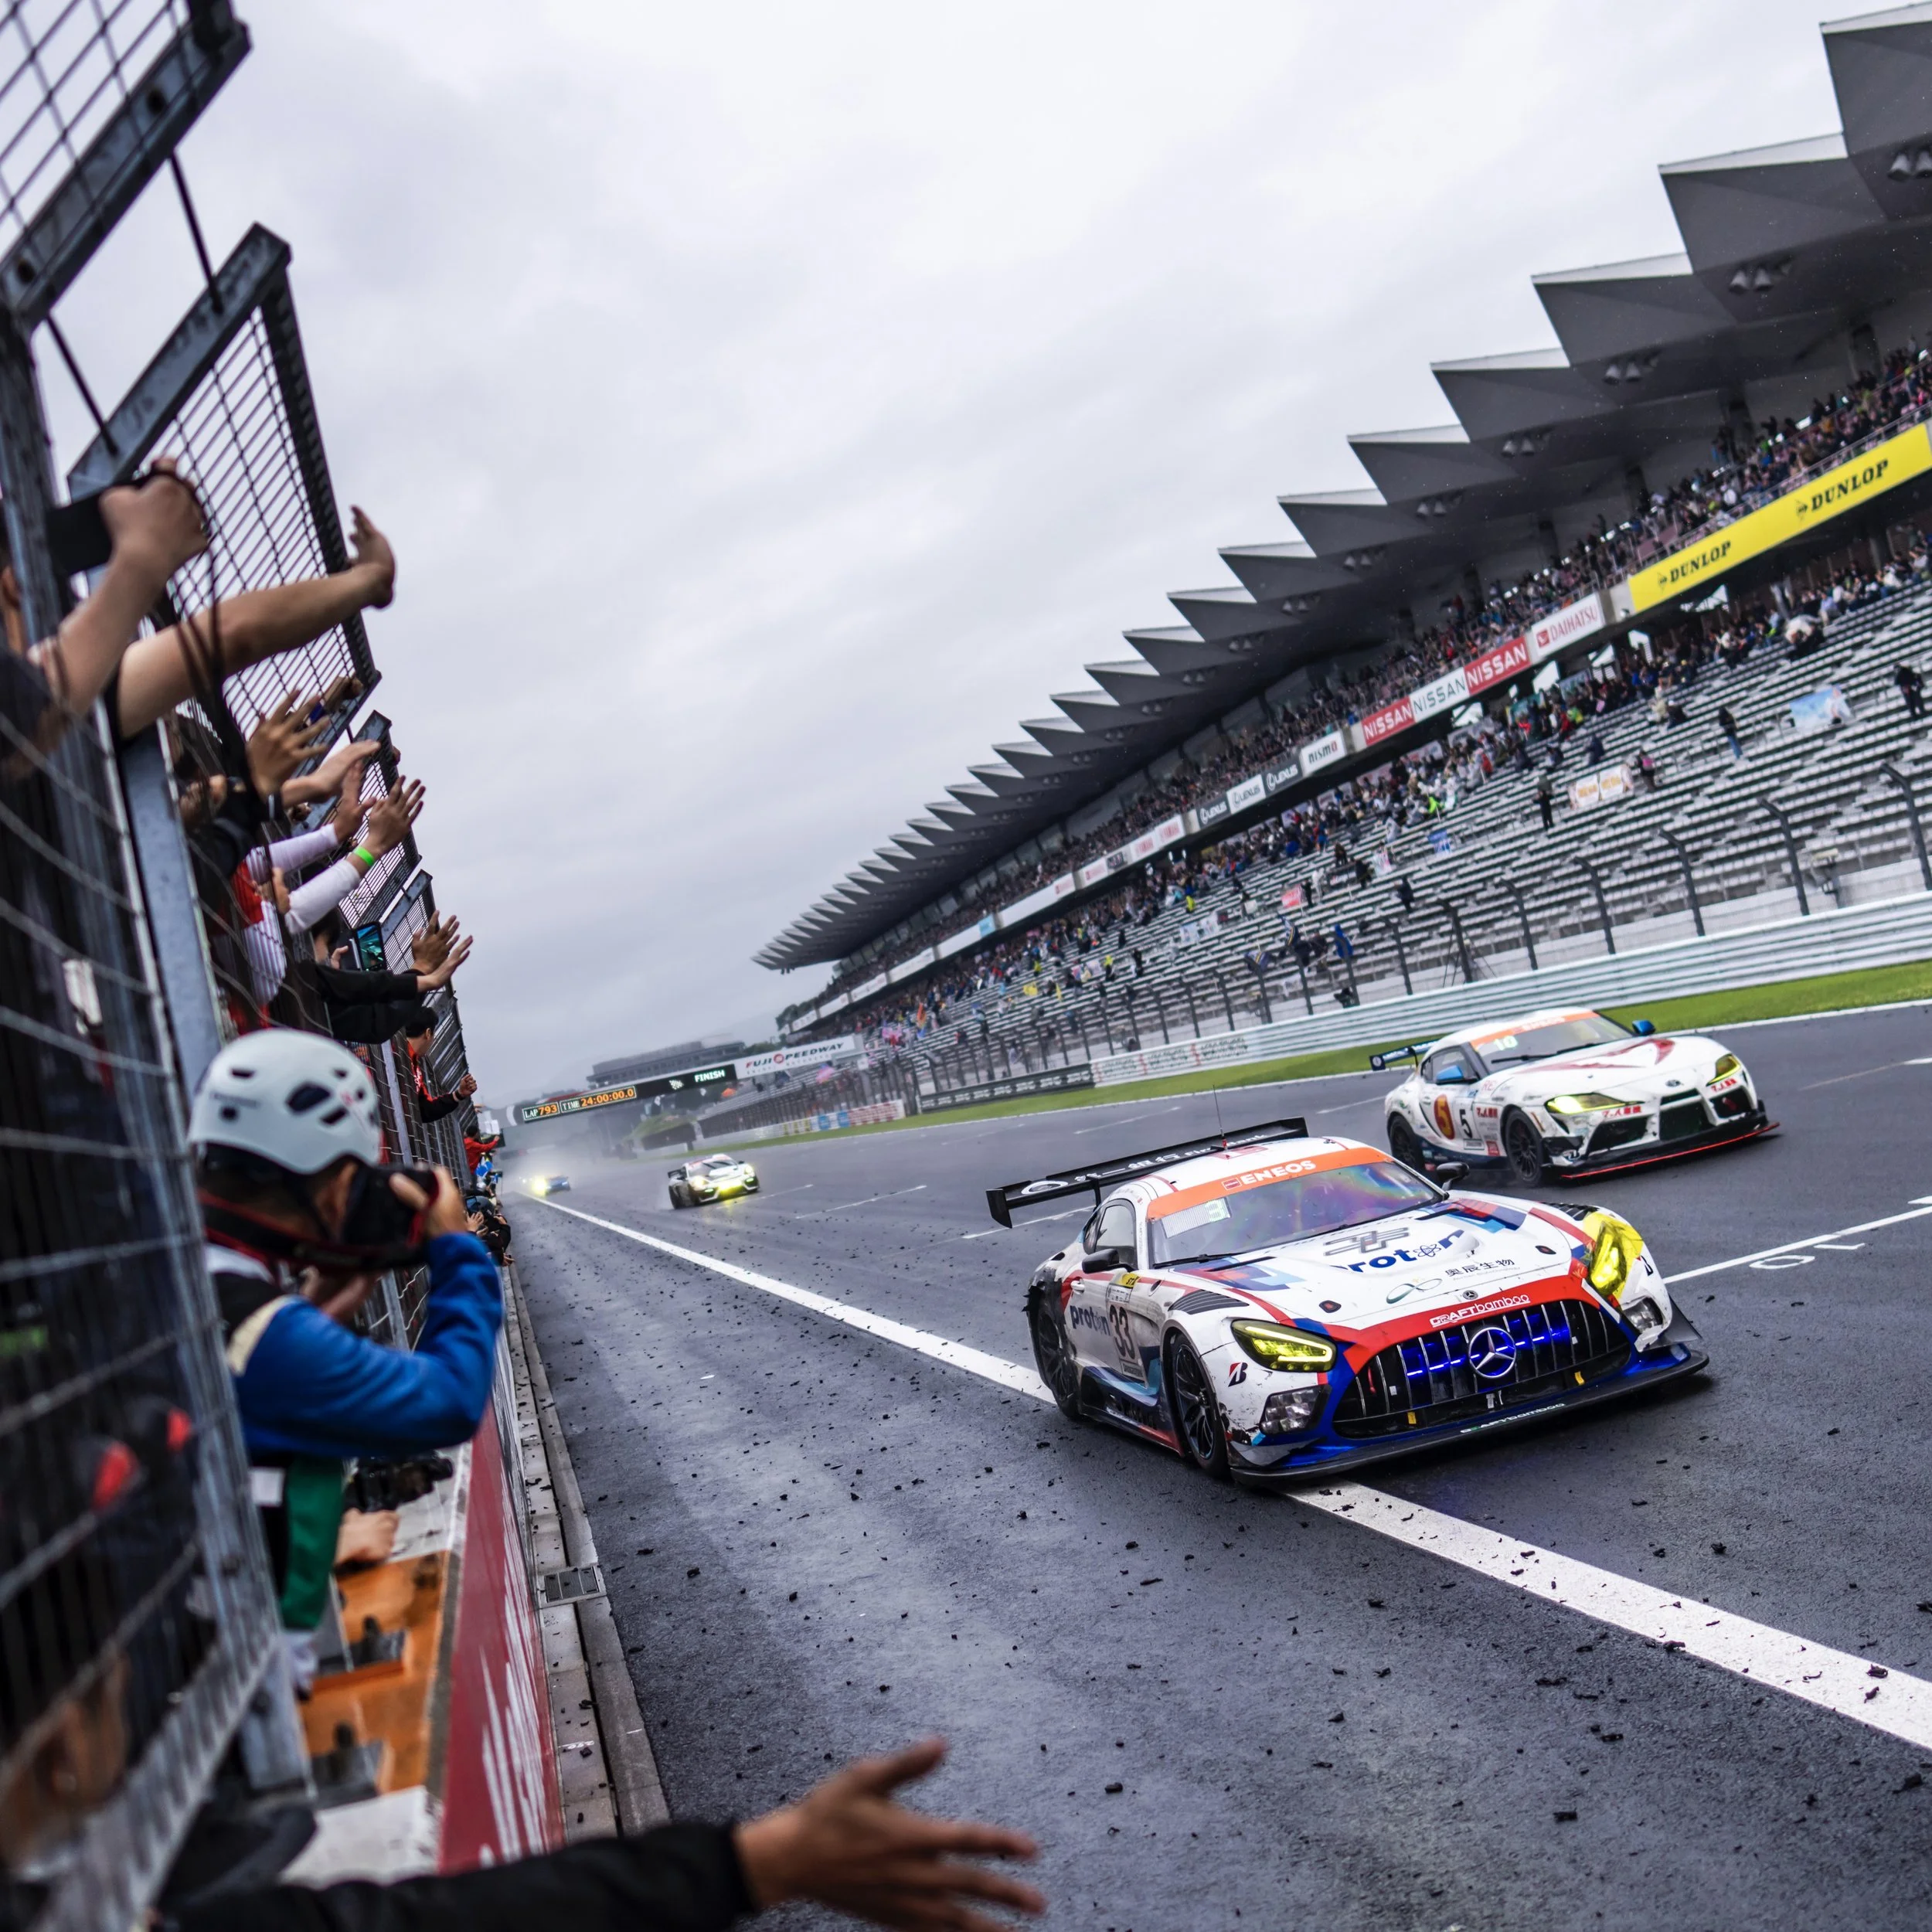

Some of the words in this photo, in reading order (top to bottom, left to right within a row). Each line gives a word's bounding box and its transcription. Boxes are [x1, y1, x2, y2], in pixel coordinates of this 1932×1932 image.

[1811, 459, 1889, 511] DUNLOP
[1669, 540, 1731, 583] DUNLOP
[1549, 604, 1599, 641] DAIHATSU
[1467, 643, 1528, 687] NISSAN
[1413, 677, 1466, 712] NISSAN
[1364, 705, 1413, 739] NISSAN
[1275, 764, 1298, 784] LEXUS
[1240, 784, 1261, 801] LEXUS
[1207, 801, 1227, 819] LEXUS
[1493, 1036, 1519, 1052] 10
[695, 1070, 726, 1082] FINISH
[745, 1058, 772, 1069] FUJI
[524, 1108, 539, 1119] LAP
[539, 1104, 557, 1115] 793
[562, 1101, 580, 1111] TIME
[581, 1088, 634, 1107] 24:00:00.0
[1437, 1097, 1452, 1137] 5
[1459, 1109, 1473, 1138] 5
[1240, 1160, 1316, 1185] ENEOS
[1109, 1304, 1135, 1360] 33
